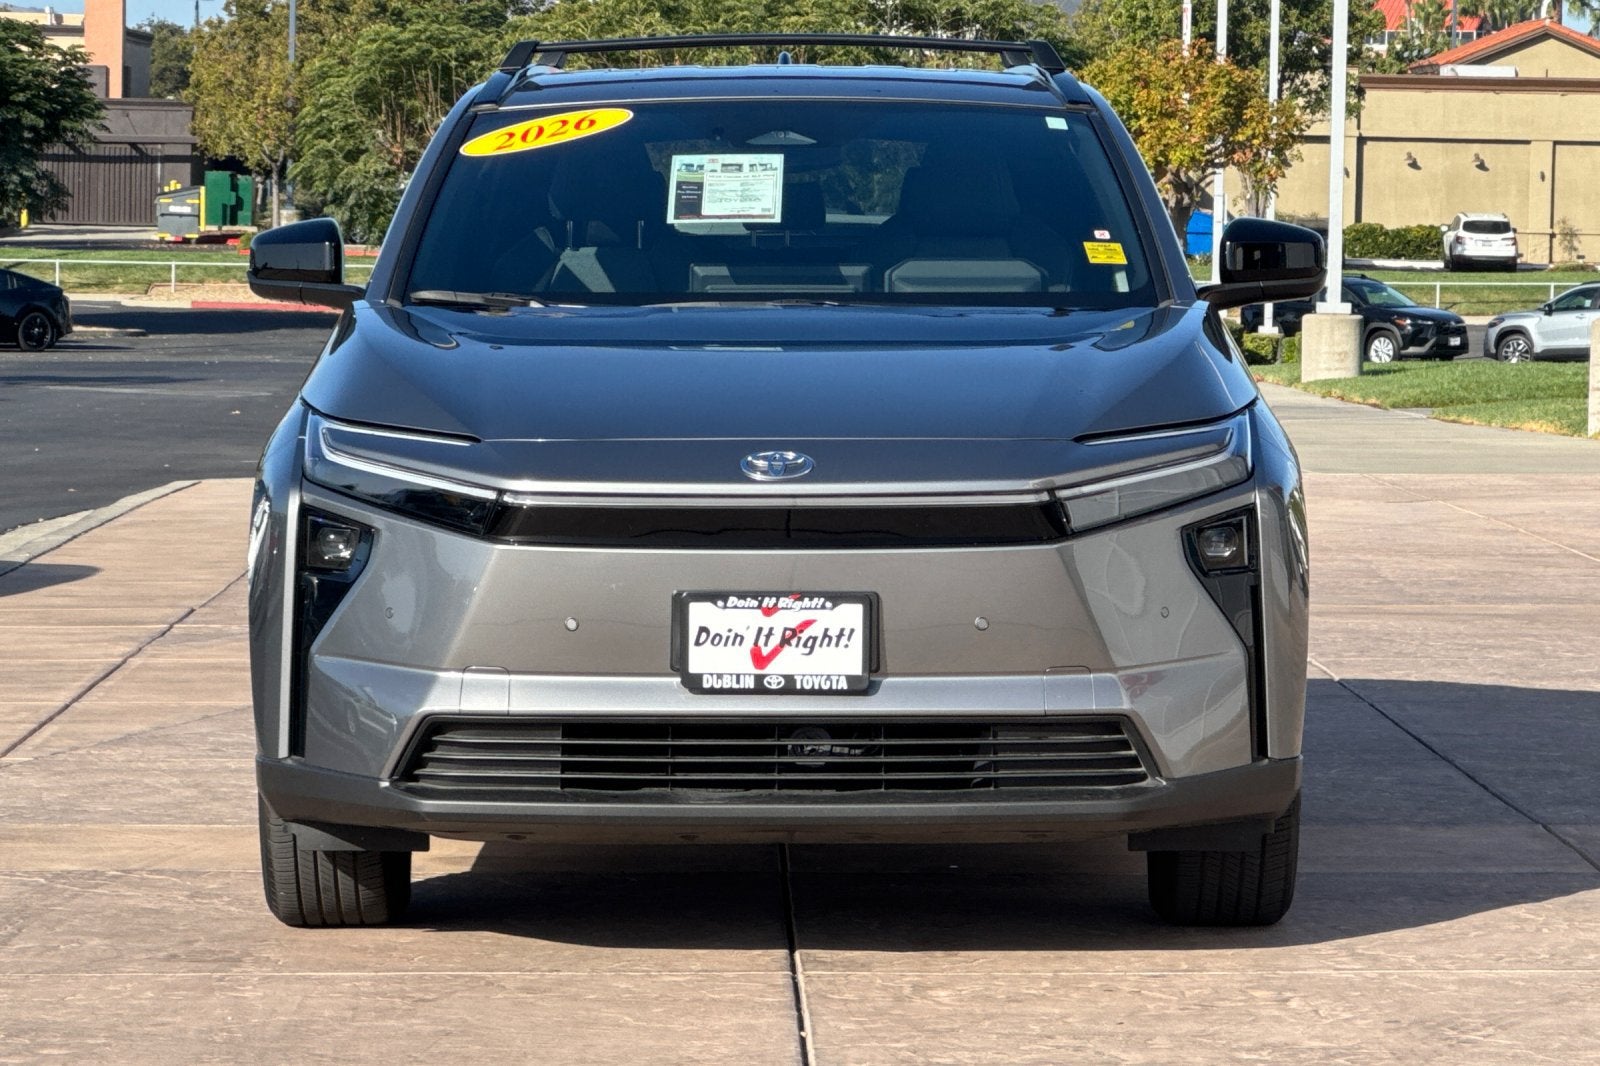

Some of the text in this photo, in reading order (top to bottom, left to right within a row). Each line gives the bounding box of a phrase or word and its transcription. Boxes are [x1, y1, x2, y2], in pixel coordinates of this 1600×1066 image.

[493, 111, 598, 152] 2026
[726, 596, 825, 612] Doin' It Right!
[693, 625, 855, 656] Doin' It Right!
[702, 674, 848, 690] DUBLIN TOYOTA
